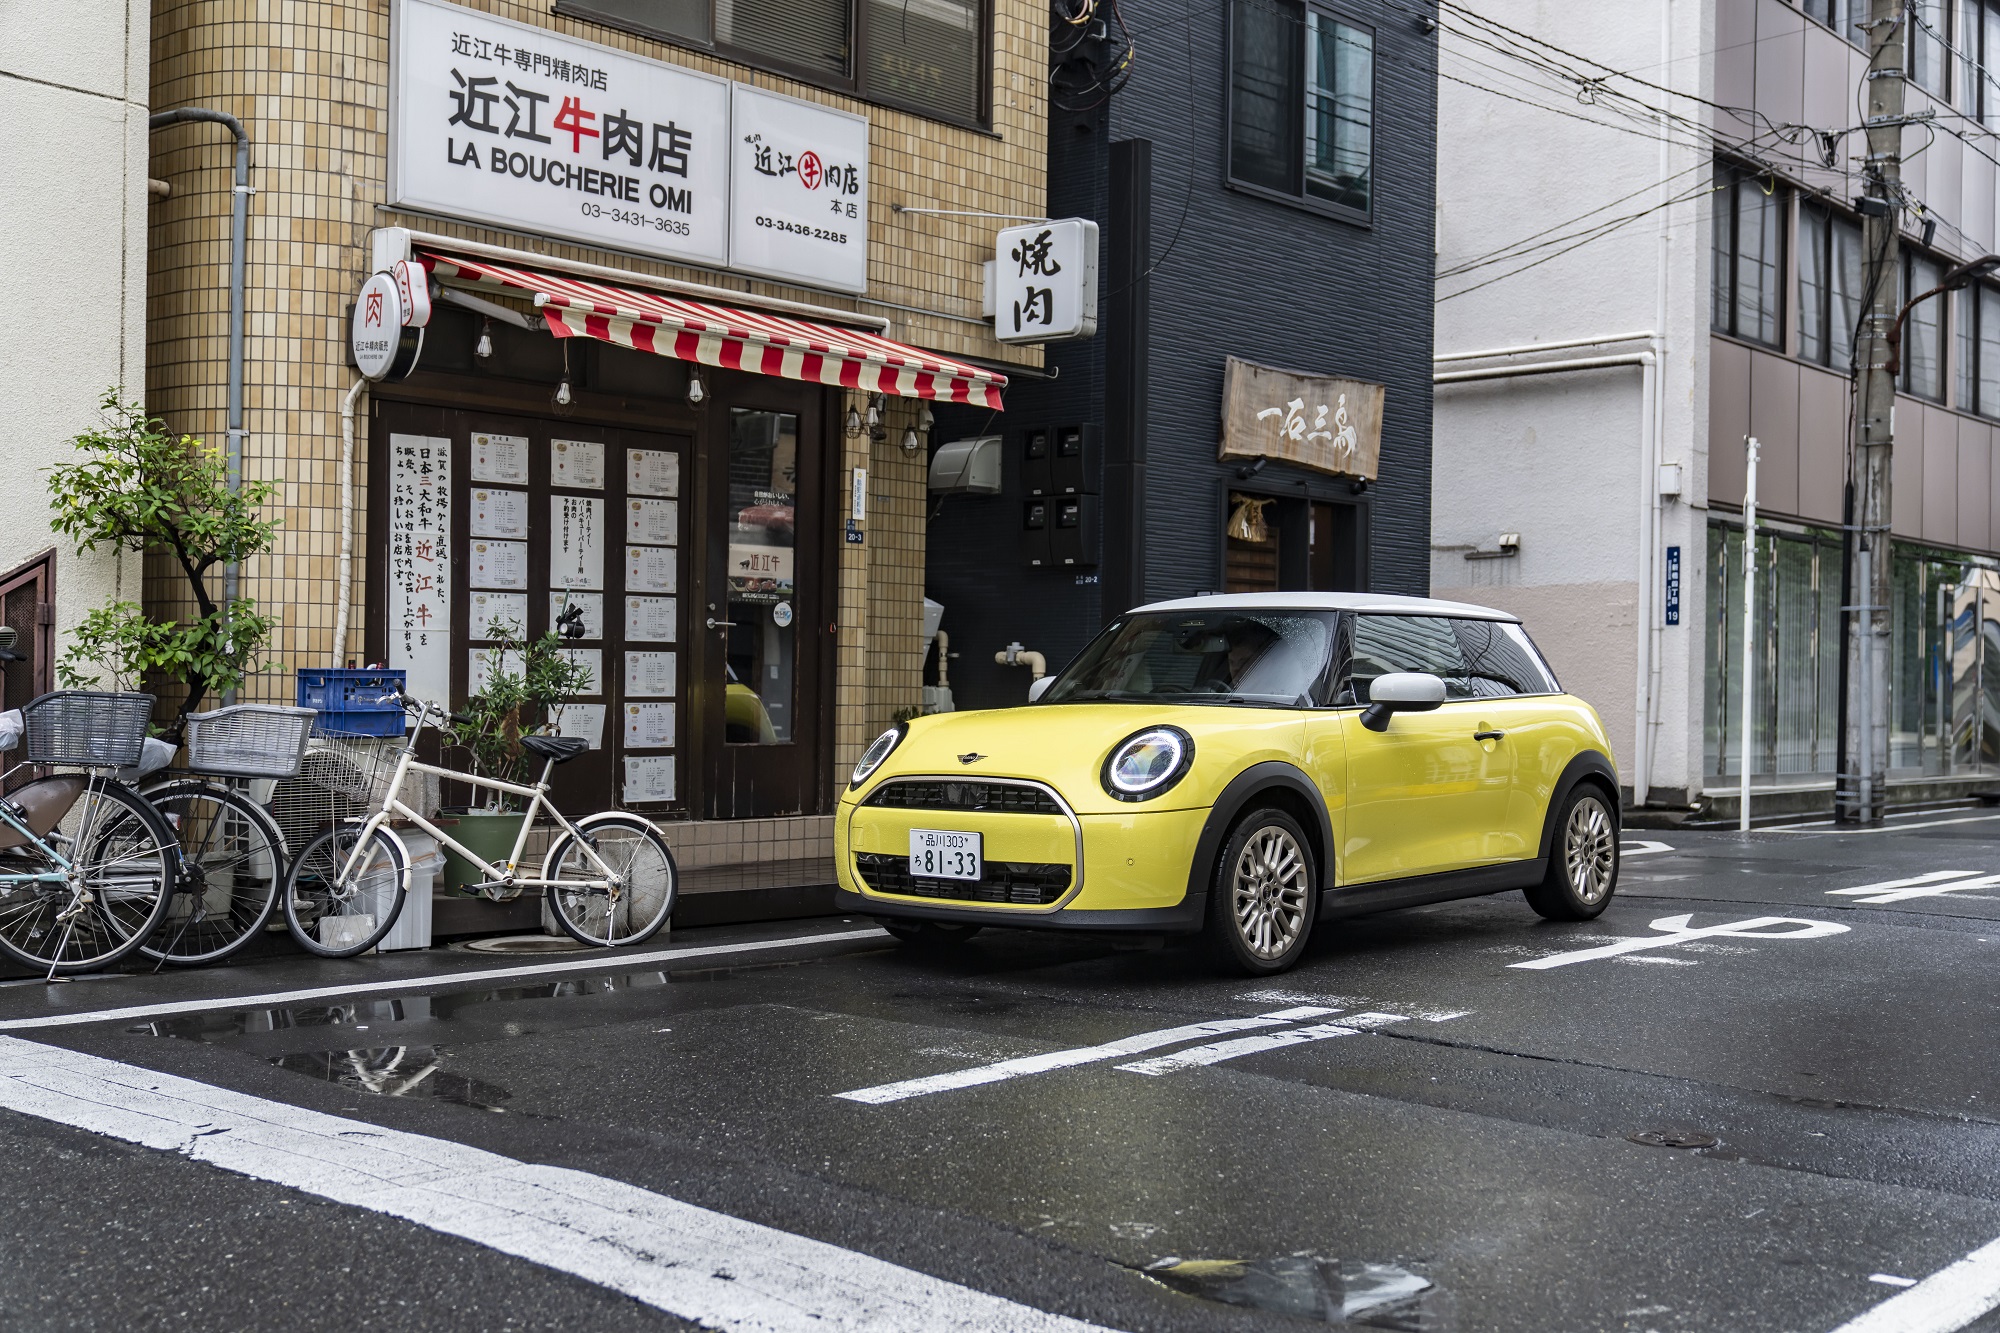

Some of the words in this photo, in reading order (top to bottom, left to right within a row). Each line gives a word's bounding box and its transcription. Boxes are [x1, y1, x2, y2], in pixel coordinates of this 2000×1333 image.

[451, 31, 608, 91] 近江牛専門精肉店
[448, 68, 692, 178] 近江牛肉店
[448, 137, 481, 169] LA
[491, 147, 640, 203] BOUCHERIE
[649, 184, 692, 214] OMI
[754, 143, 859, 195] 近江牛肉店
[581, 202, 690, 236] 03-3431-3635
[830, 198, 857, 219] 本店
[755, 216, 847, 244] 03-3436-2285
[1012, 229, 1061, 332] 焼肉
[365, 287, 383, 328] 肉
[848, 533, 862, 541] 20-3
[750, 554, 780, 572] 近江牛
[1667, 611, 1678, 620] 19
[914, 854, 922, 867] ち
[925, 849, 976, 876] 81-33
